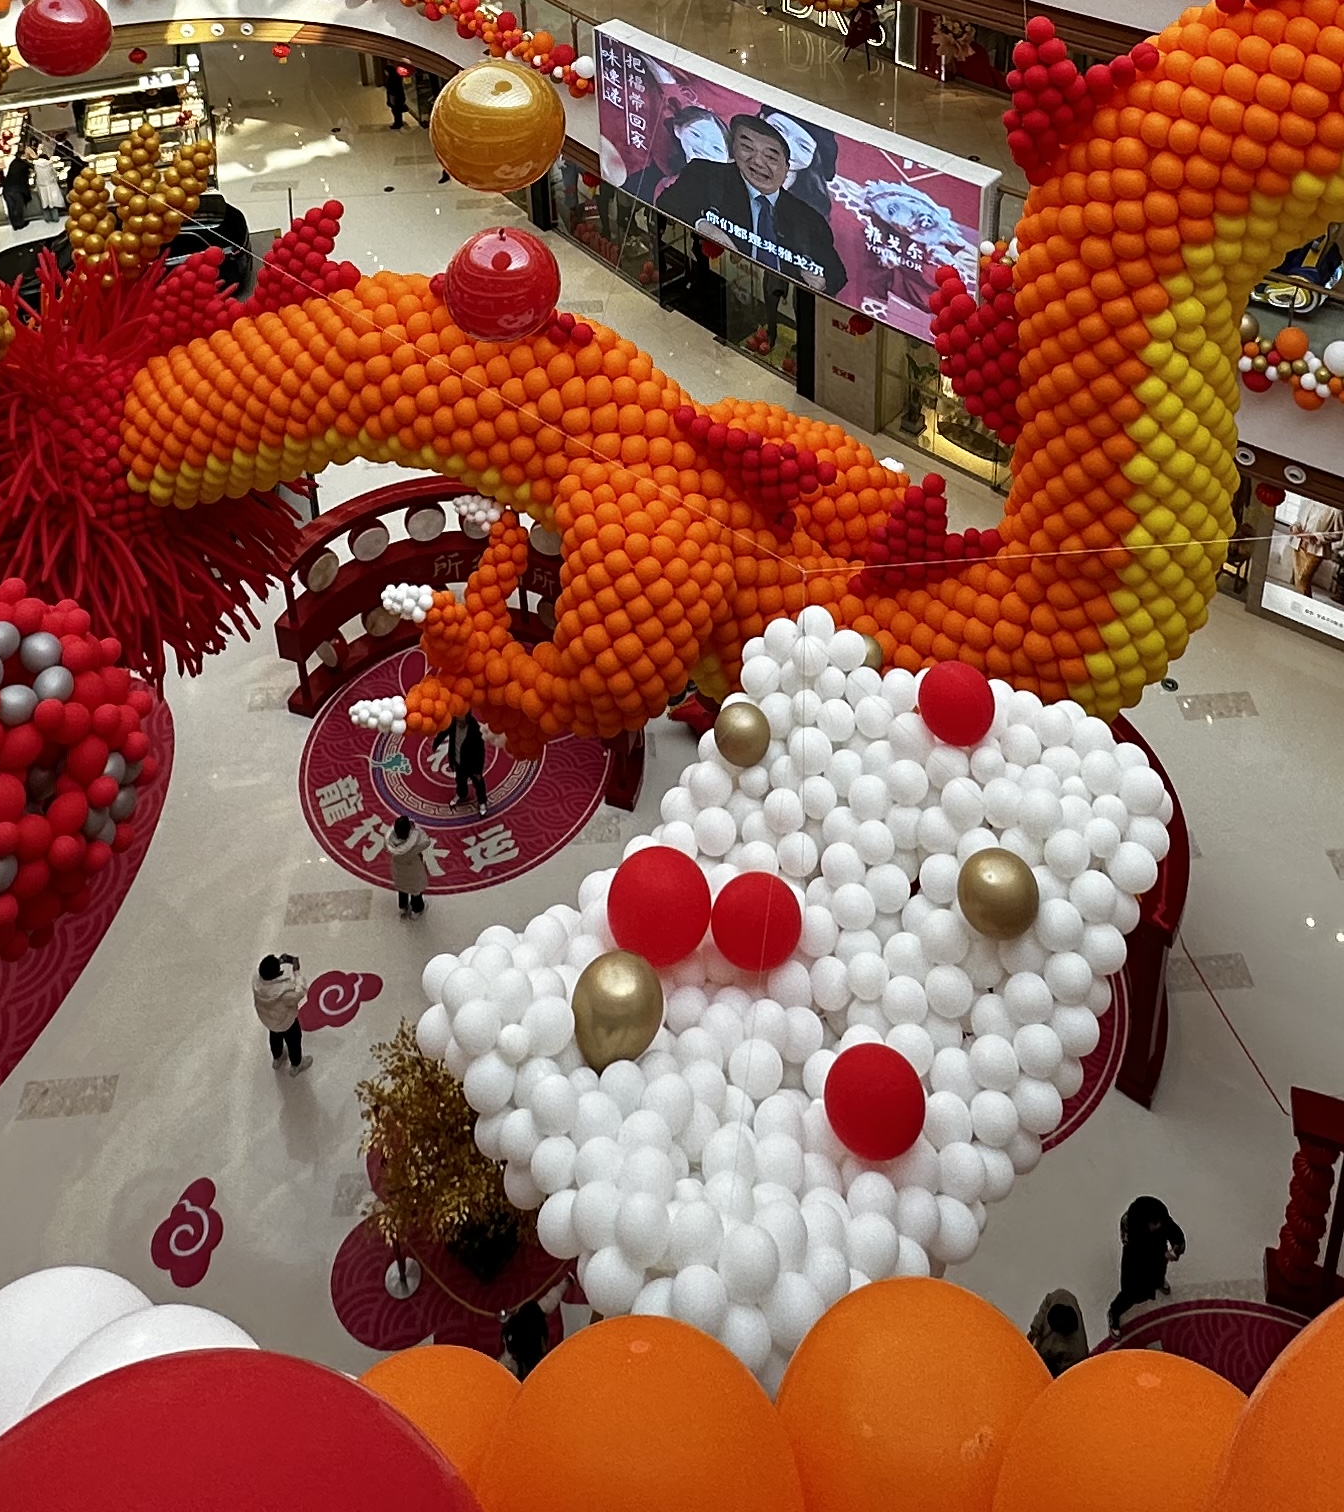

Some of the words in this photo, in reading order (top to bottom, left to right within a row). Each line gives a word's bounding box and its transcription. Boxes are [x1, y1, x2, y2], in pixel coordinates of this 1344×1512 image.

[625, 51, 649, 151] 把福带回家
[705, 210, 825, 278] 你们都是来雅戈尔
[864, 226, 924, 261] 雅戈尔
